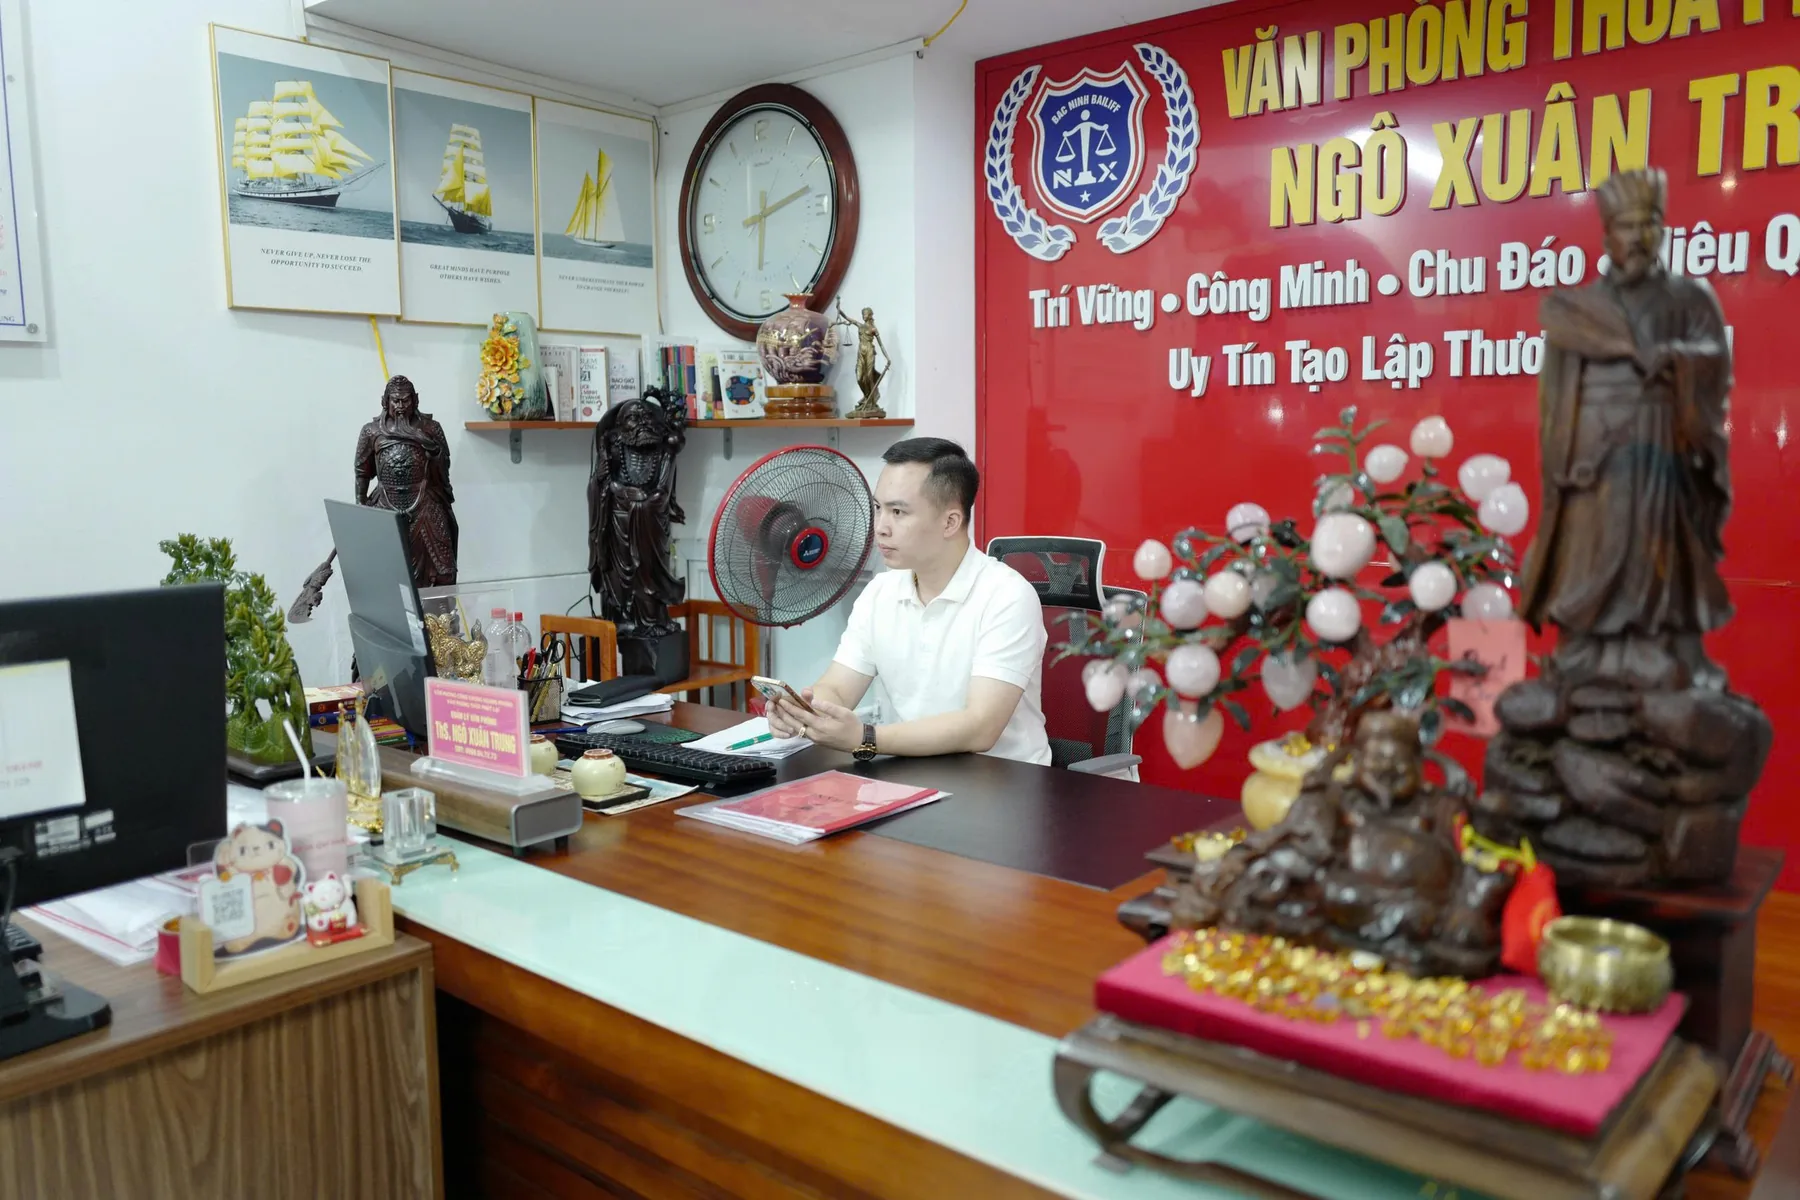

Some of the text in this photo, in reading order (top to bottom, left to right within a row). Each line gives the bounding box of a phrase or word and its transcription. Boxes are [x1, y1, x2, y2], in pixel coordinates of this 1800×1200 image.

[1222, 25, 1321, 118] VĂN
[1051, 94, 1121, 124] BAC NINH BAILIFF
[1270, 111, 1405, 228] NGÔ
[1429, 82, 1651, 209] XUÂN
[261, 248, 284, 256] NEVER
[286, 250, 303, 258] GIVE
[317, 253, 339, 261] NEVER
[340, 255, 357, 263] LOSE
[359, 256, 372, 264] THE
[271, 259, 320, 269] OPPORTUNITY
[1029, 284, 1071, 328] Trí
[1077, 283, 1154, 330] Vững
[1187, 271, 1271, 321] Công
[1280, 258, 1369, 308] Minh
[1409, 249, 1486, 297] Chu
[1497, 235, 1586, 291] Đáo
[1169, 329, 1547, 397] Uy Tín Tạo Lập Thươ
[452, 722, 467, 744] NGÔ
[468, 725, 490, 749] XUÂN
[490, 731, 516, 754] TRUNG
